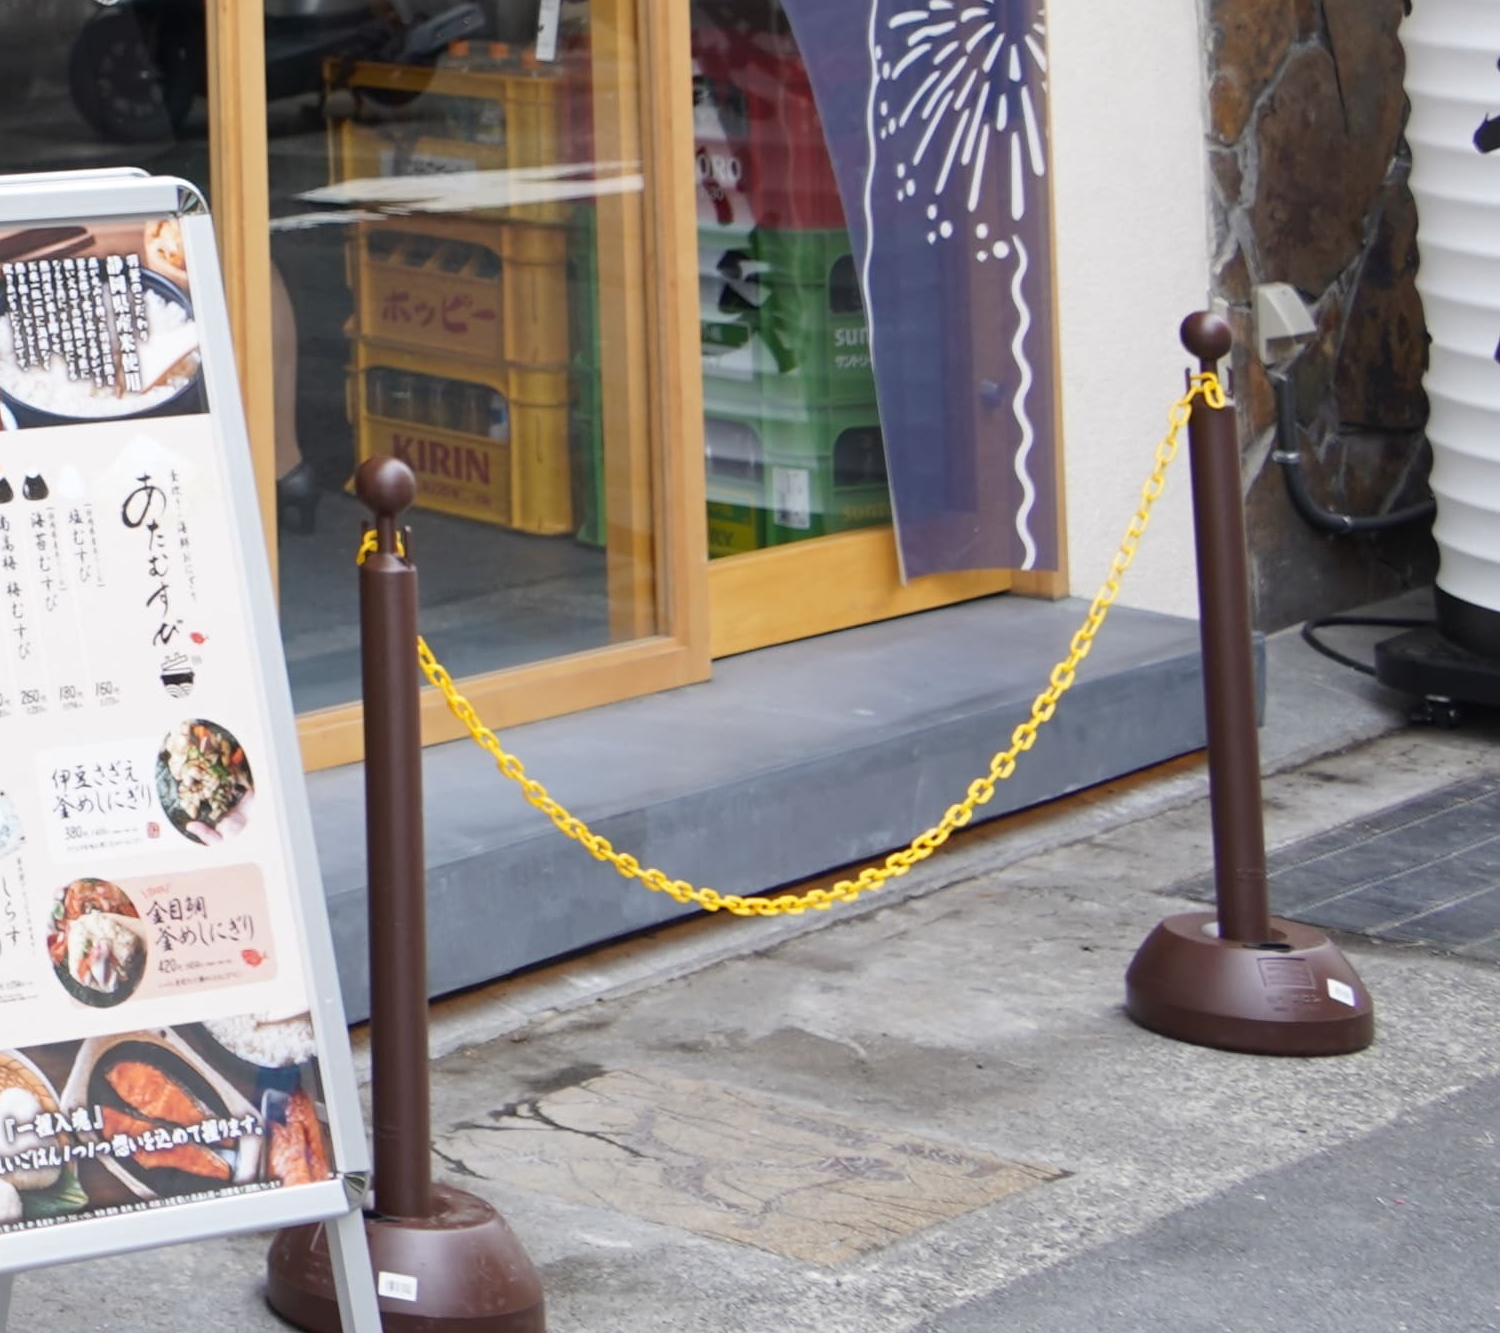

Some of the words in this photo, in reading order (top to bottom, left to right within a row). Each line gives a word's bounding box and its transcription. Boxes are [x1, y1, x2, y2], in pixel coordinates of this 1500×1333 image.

[391, 433, 491, 486] KIRIN
[120, 473, 184, 647] あたむすび
[50, 759, 142, 791] 伊豆さざえ
[52, 783, 153, 819] 釜めしにぎり
[155, 916, 255, 952] 釜めしにぎり
